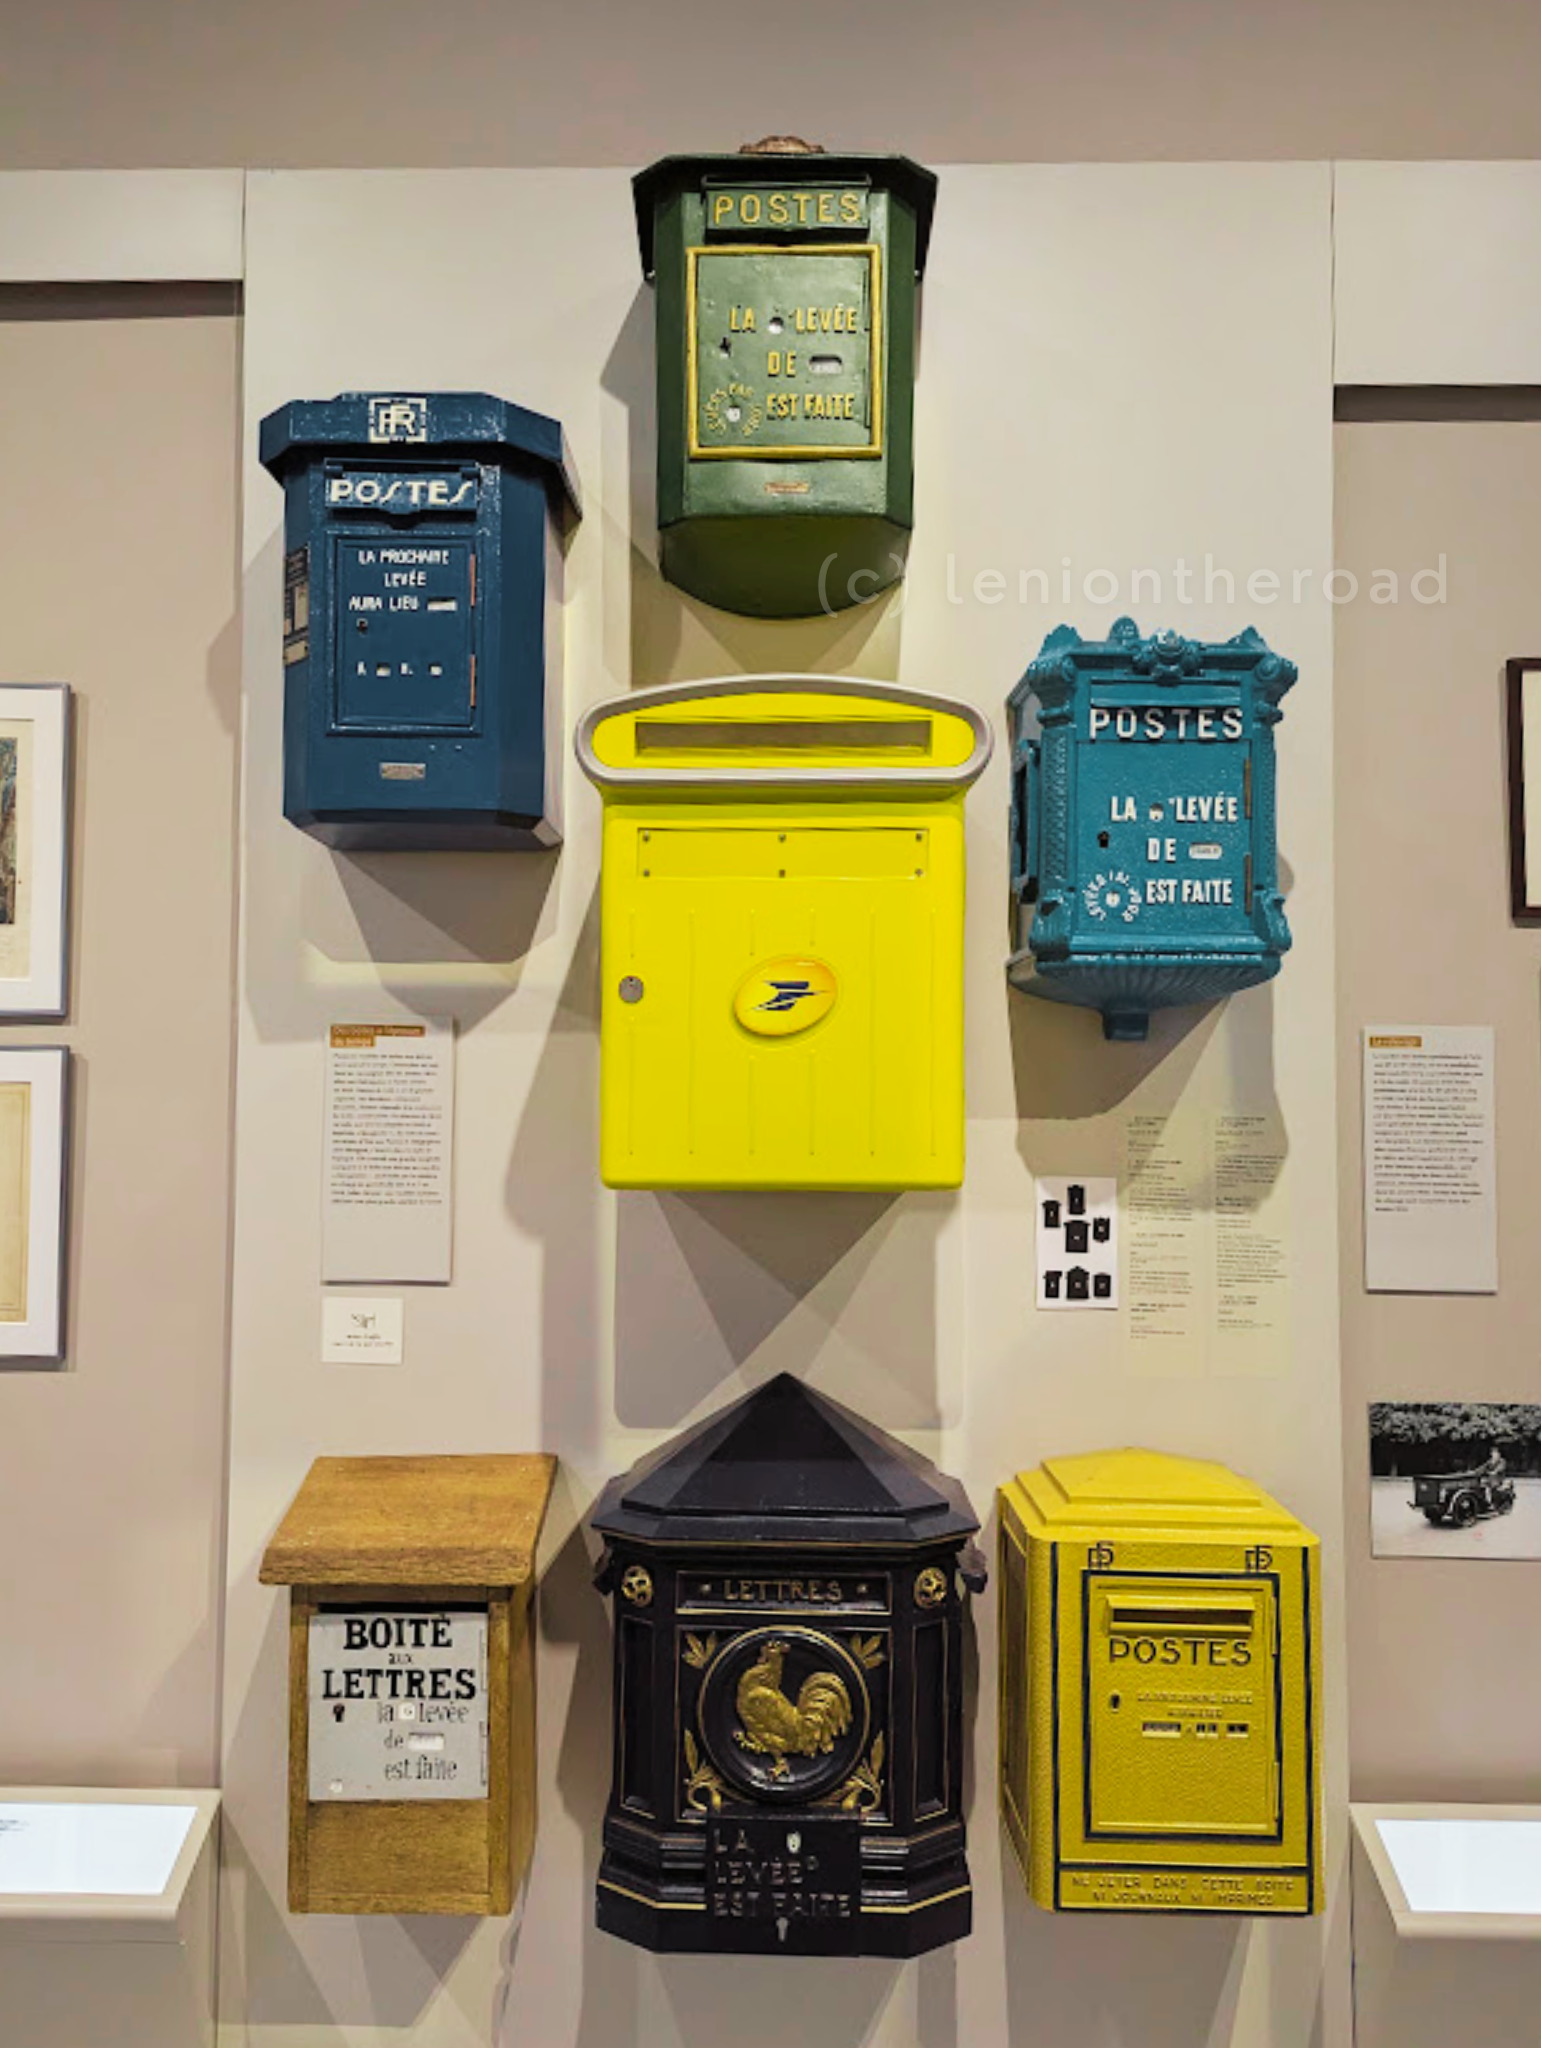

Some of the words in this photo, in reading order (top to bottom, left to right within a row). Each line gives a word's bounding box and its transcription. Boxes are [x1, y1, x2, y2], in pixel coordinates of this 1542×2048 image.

[713, 193, 861, 224] POSTES
[730, 306, 756, 333] LA
[795, 304, 857, 333] LEVÉE
[768, 351, 796, 376] DE
[767, 393, 802, 420] EST
[804, 393, 855, 420] FAITE
[329, 480, 473, 503] POSTES
[358, 550, 375, 565] LA
[1089, 708, 1244, 739] POSTES
[1110, 796, 1137, 822] LA
[1175, 791, 1238, 822] LEVÉE
[1147, 837, 1177, 862] DE
[1146, 879, 1179, 905] EST
[1181, 878, 1233, 905] FAITE
[724, 1579, 842, 1601] LETTRES
[1109, 1637, 1252, 1666] POSTES
[322, 1668, 477, 1700] LETTRES
[377, 1701, 393, 1723] la
[383, 1729, 404, 1749] de
[385, 1758, 412, 1781] est
[415, 1754, 457, 1780] faite
[713, 1829, 755, 1854] LA
[713, 1892, 760, 1917] EST
[771, 1892, 851, 1917] FAITE
